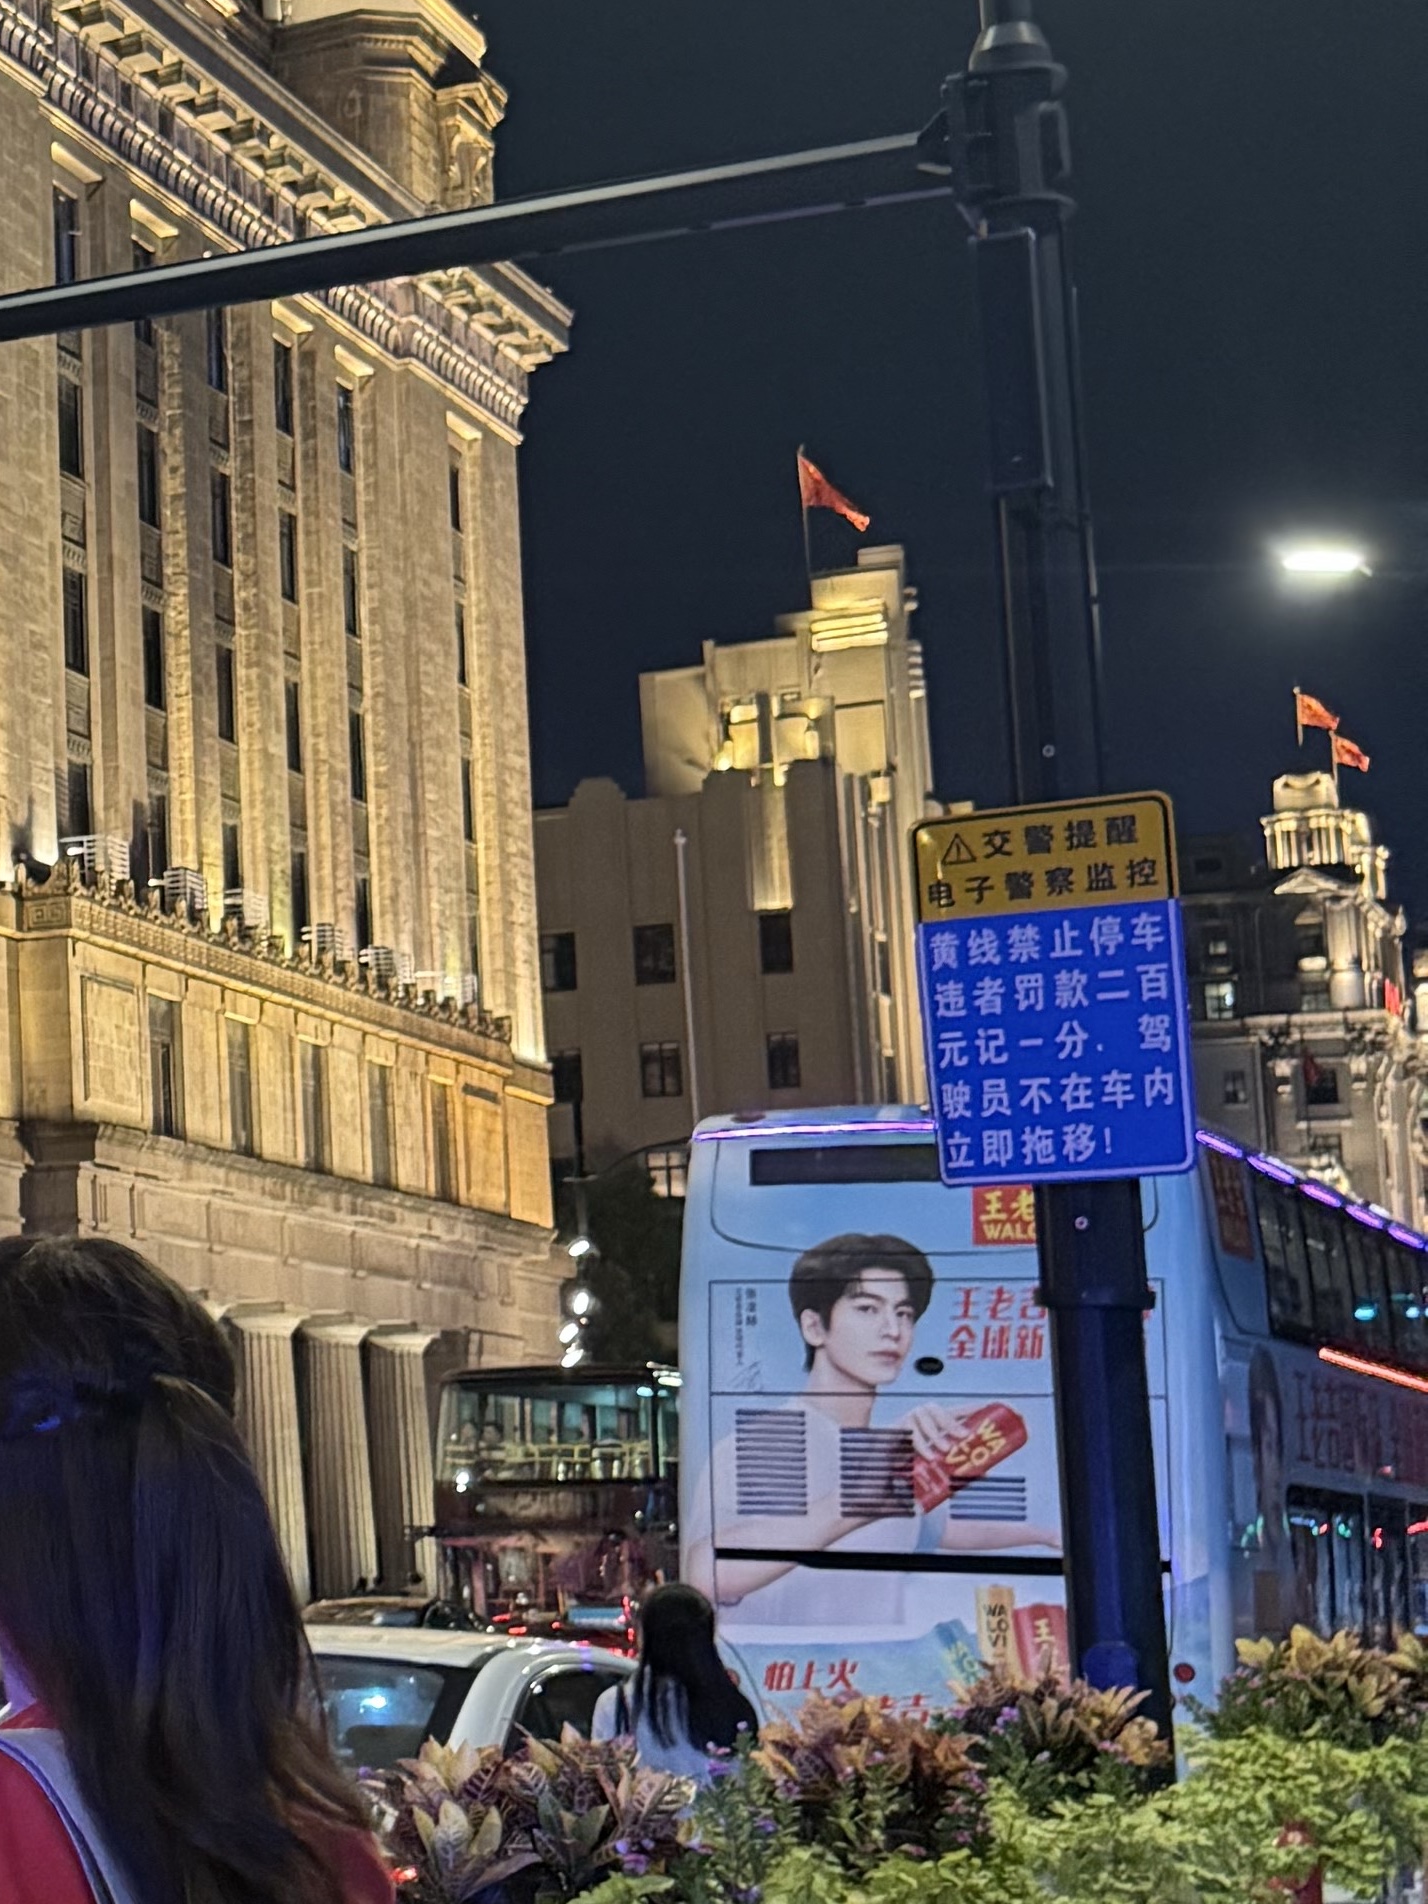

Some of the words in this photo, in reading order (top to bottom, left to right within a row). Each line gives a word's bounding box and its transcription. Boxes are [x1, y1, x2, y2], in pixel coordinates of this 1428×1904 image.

[982, 814, 1138, 860] 交警提醒
[928, 857, 1159, 909] 电子警察监控
[929, 911, 1165, 971] 黄线禁止停车
[934, 963, 1169, 1019] 违者罚款二百
[941, 1066, 1175, 1120] 驶员不在车内
[763, 1657, 859, 1692] 怕上火
